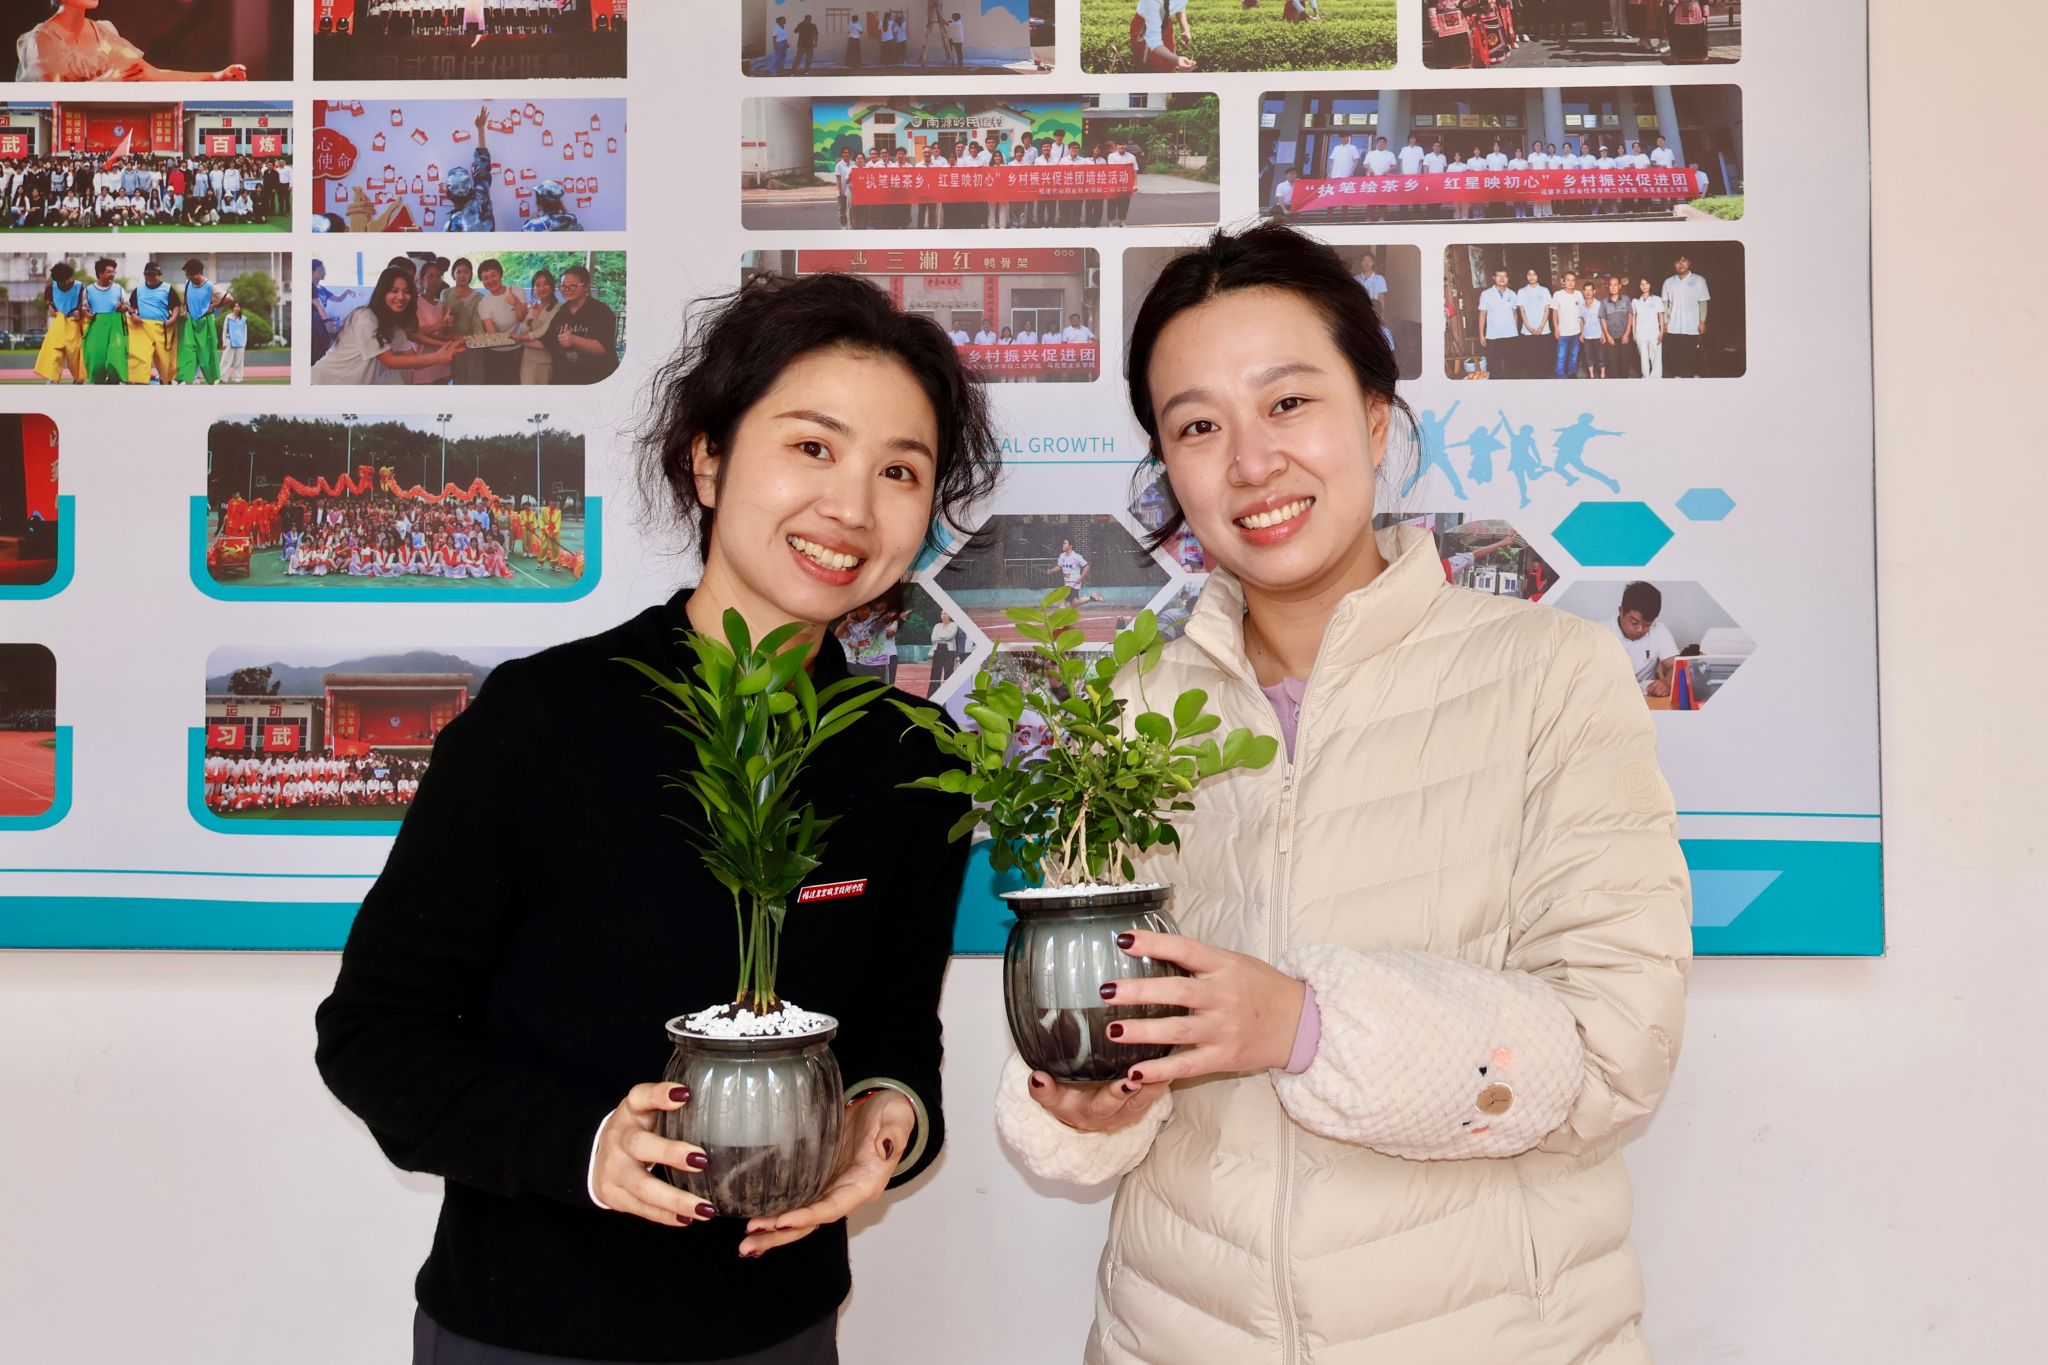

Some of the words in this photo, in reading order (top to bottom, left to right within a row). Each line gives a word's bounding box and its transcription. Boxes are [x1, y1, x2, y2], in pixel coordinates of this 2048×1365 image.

[1, 135, 20, 154] 武
[213, 136, 229, 154] 百
[259, 136, 275, 153] 炼
[316, 137, 334, 152] 心
[318, 153, 352, 170] 使命
[1028, 437, 1114, 453] GROWTH
[217, 726, 237, 746] 习
[271, 727, 292, 746] 武
